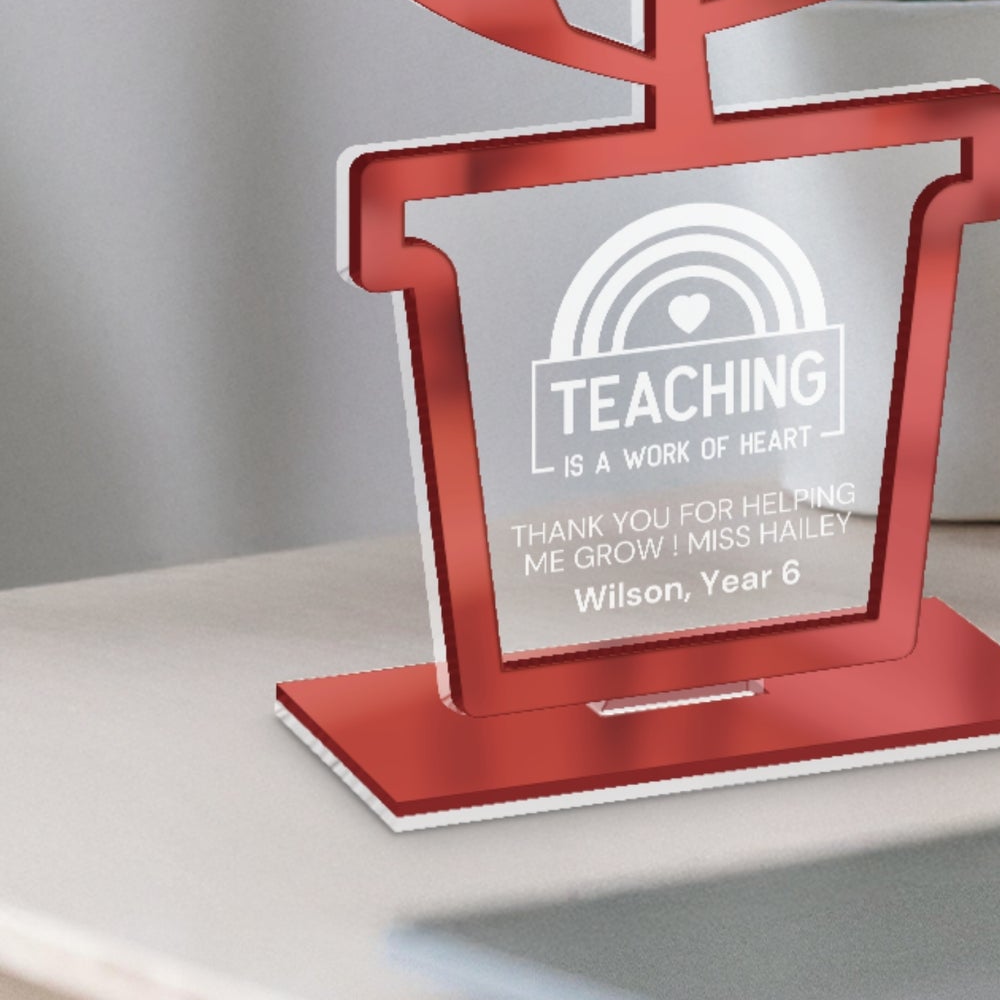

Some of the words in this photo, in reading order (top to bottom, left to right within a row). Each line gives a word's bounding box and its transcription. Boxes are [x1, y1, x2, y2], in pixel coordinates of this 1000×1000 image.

[550, 350, 827, 435] TEACHING
[564, 455, 584, 478] IS
[595, 451, 610, 474] A
[623, 441, 690, 470] WORK
[701, 435, 729, 460] OF
[740, 425, 812, 456] HEART
[511, 515, 604, 547] THANK
[613, 506, 670, 532] YOU
[680, 499, 733, 525] FOR
[743, 482, 856, 517] HELPING
[525, 550, 564, 576] ME
[574, 536, 664, 568] GROW
[672, 533, 679, 556] !
[688, 526, 750, 554] MISS
[760, 511, 852, 544] HAILEY
[574, 581, 691, 613] Wilson,
[700, 568, 772, 596] Year
[781, 559, 801, 586] 6
